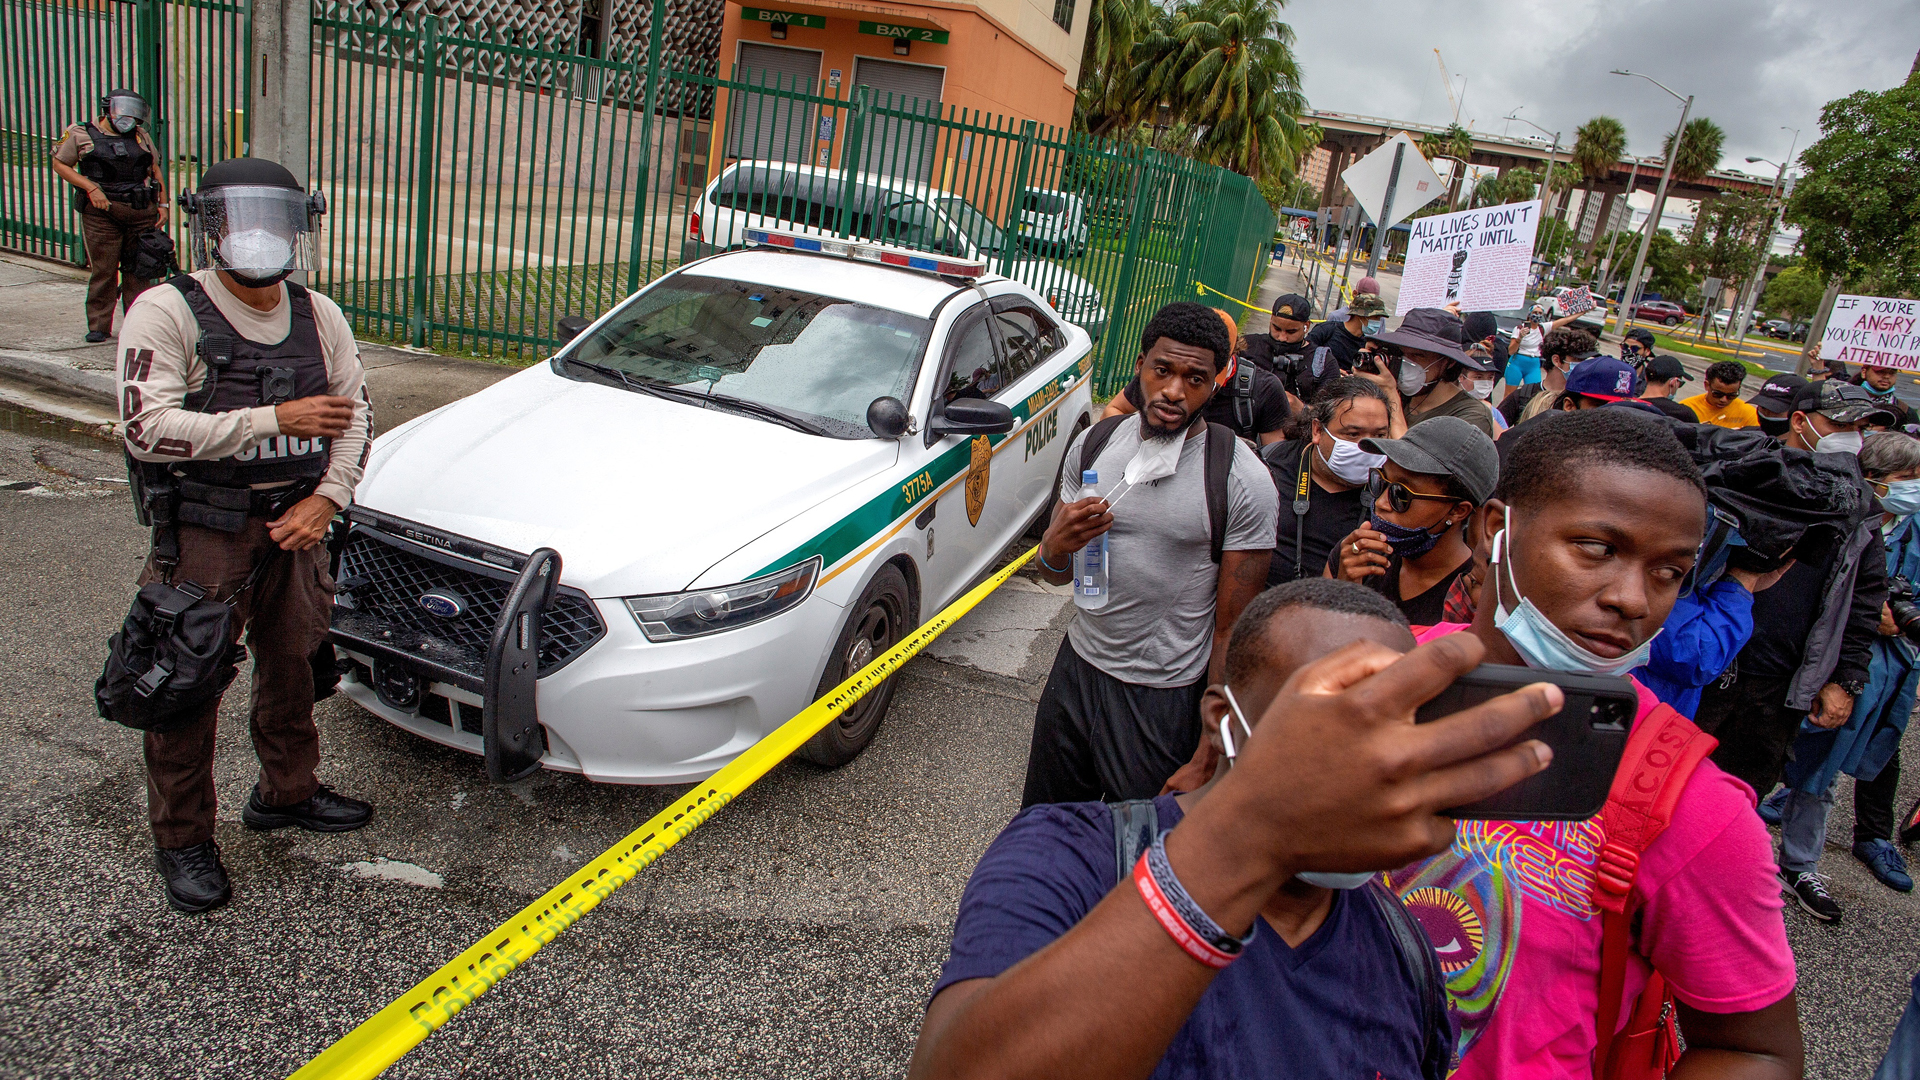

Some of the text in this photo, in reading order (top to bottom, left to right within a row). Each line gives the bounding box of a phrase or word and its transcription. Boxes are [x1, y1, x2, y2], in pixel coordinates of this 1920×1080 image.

[758, 10, 808, 26] BAY 1
[876, 24, 933, 41] BAY 2
[1411, 206, 1533, 240] ALL LIVES DON'T
[1420, 232, 1473, 254] MATTER
[1560, 286, 1589, 303] BLACK
[1567, 295, 1588, 308] LIVES
[1564, 300, 1592, 317] MATTER
[1837, 298, 1916, 315] IF YOU'RE
[1854, 313, 1917, 334] ANGRY,
[1827, 327, 1872, 347] YOU'RE
[1877, 333, 1909, 350] NOT
[1837, 346, 1919, 369] ATTENTION
[1027, 379, 1061, 417] MIAMI-DADE
[1024, 407, 1059, 463] POLICE
[208, 433, 324, 462] OLICE
[902, 470, 934, 505] 3775A
[1298, 471, 1308, 496] Nikon
[406, 529, 453, 549] SETINA
[426, 598, 450, 613] Ford
